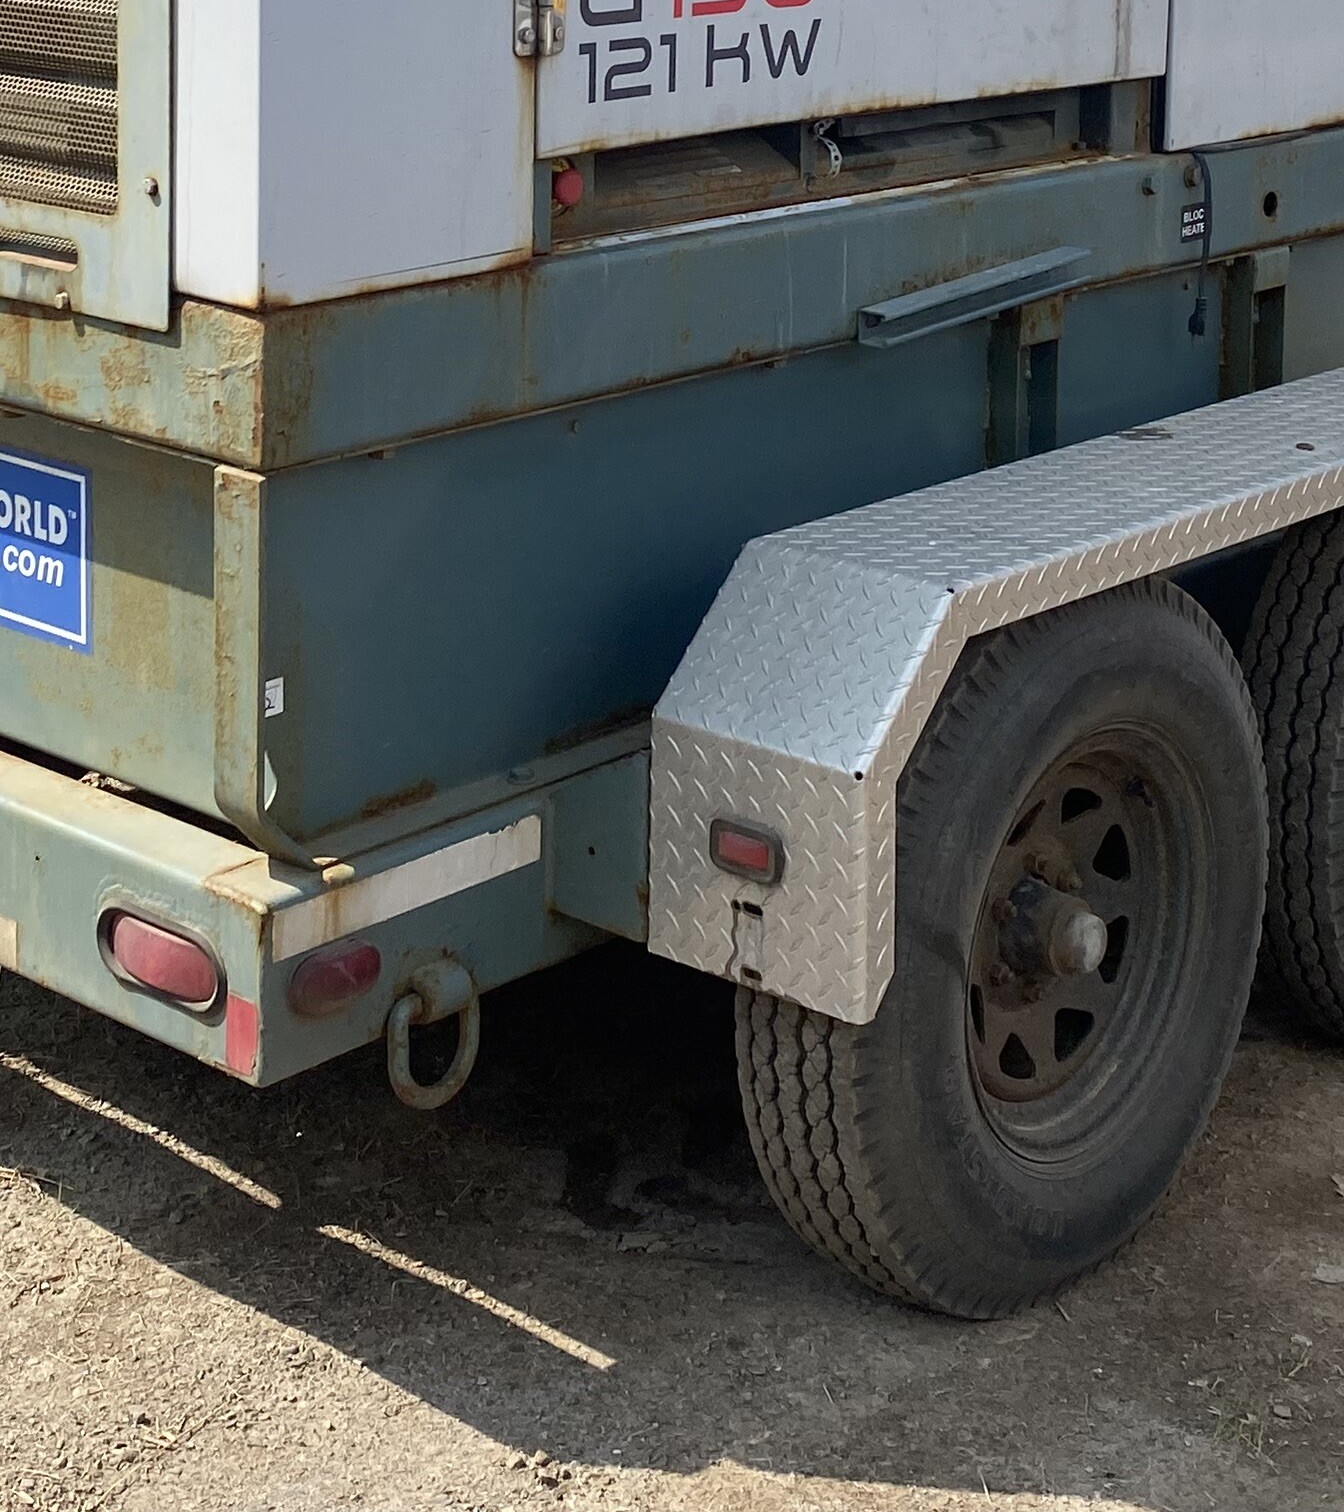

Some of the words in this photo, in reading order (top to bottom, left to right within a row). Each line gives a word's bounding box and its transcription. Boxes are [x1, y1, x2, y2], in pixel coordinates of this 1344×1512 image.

[578, 33, 677, 103] 121
[1183, 208, 1205, 223] BLOC
[1181, 222, 1205, 238] HEATE
